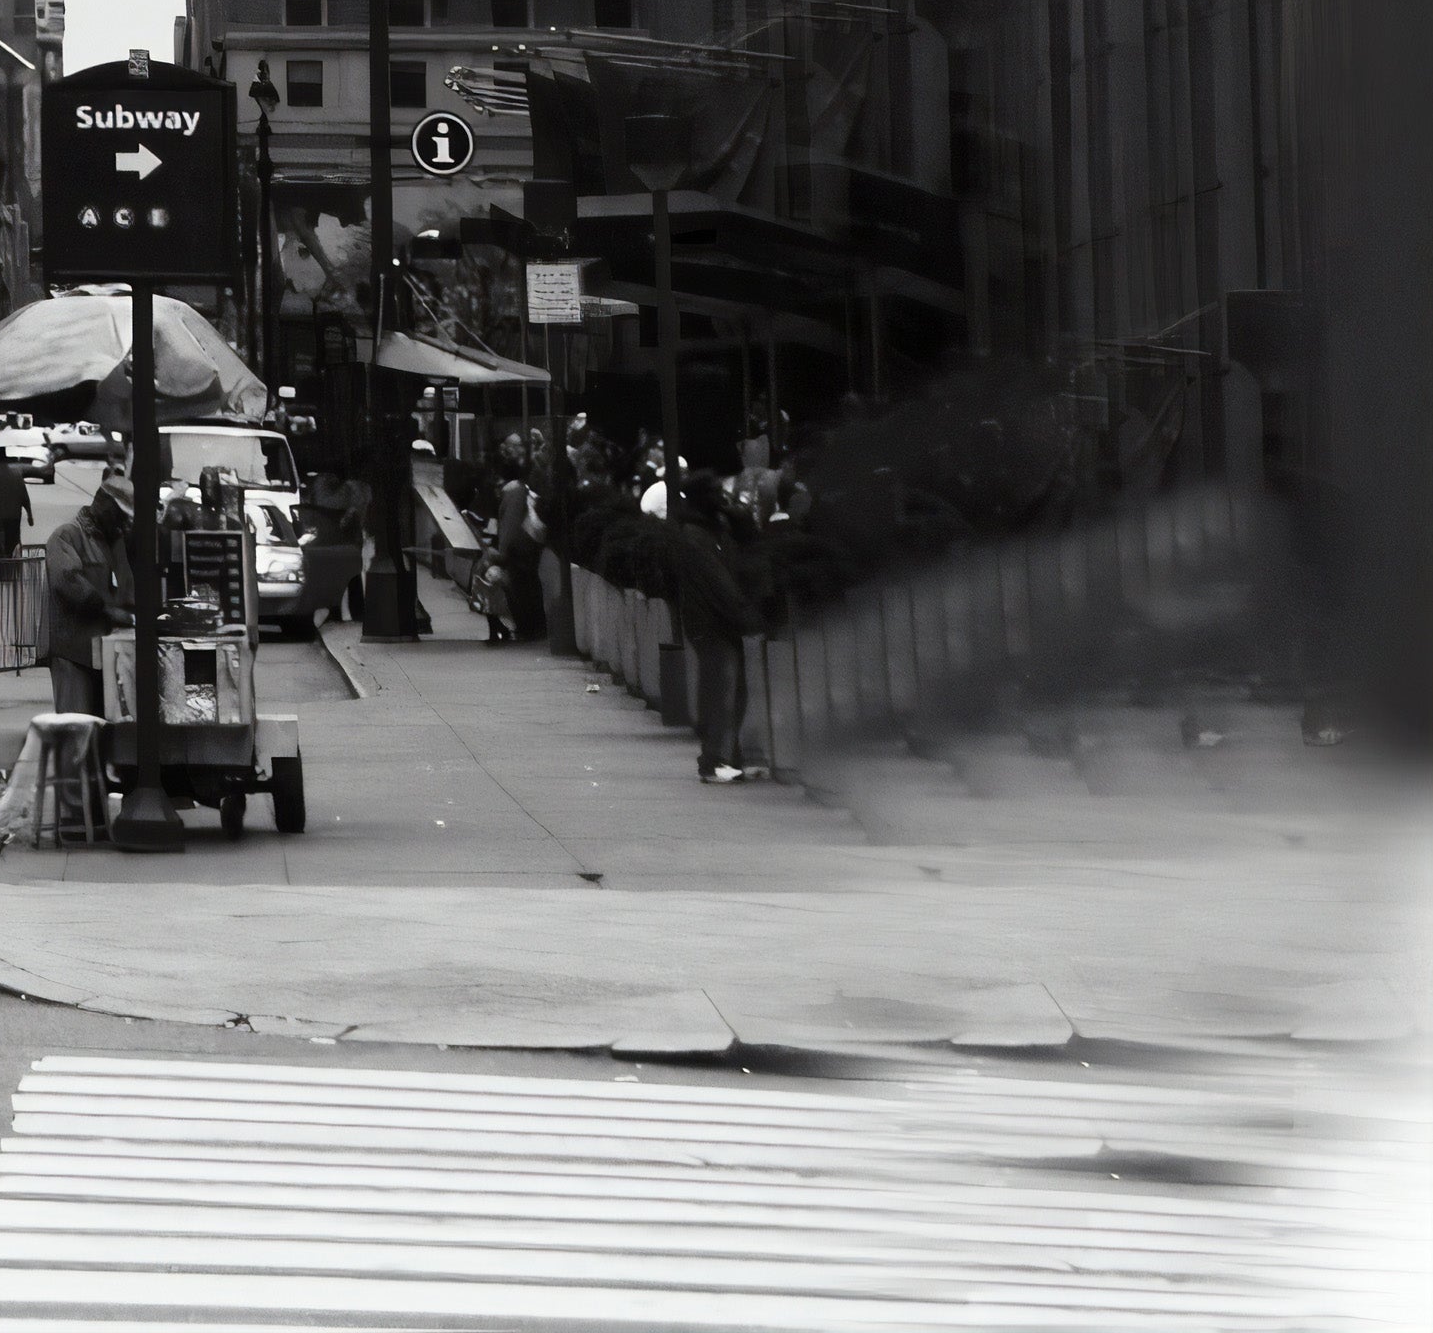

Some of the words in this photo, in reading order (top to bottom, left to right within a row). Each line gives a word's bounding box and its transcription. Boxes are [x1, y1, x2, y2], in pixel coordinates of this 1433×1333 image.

[76, 104, 200, 136] Subway
[81, 208, 98, 227] A
[115, 208, 131, 226] C
